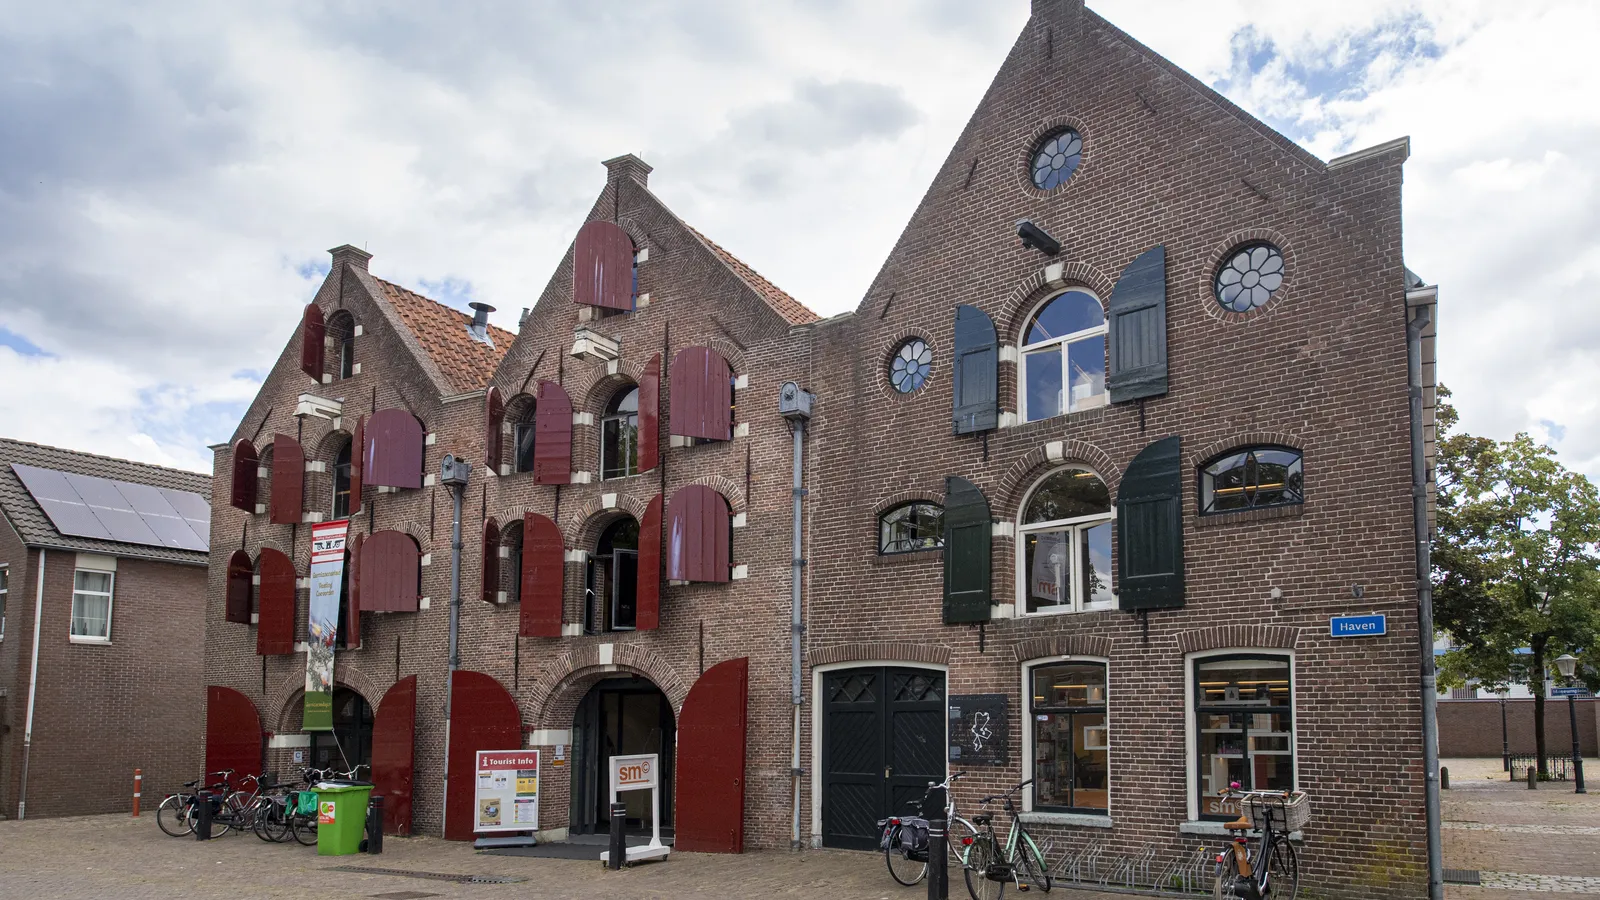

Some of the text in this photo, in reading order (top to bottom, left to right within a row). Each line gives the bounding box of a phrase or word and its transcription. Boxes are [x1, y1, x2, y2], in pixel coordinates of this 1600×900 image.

[1340, 622, 1376, 631] Haven
[489, 757, 516, 766] Tourist
[517, 756, 534, 765] Info
